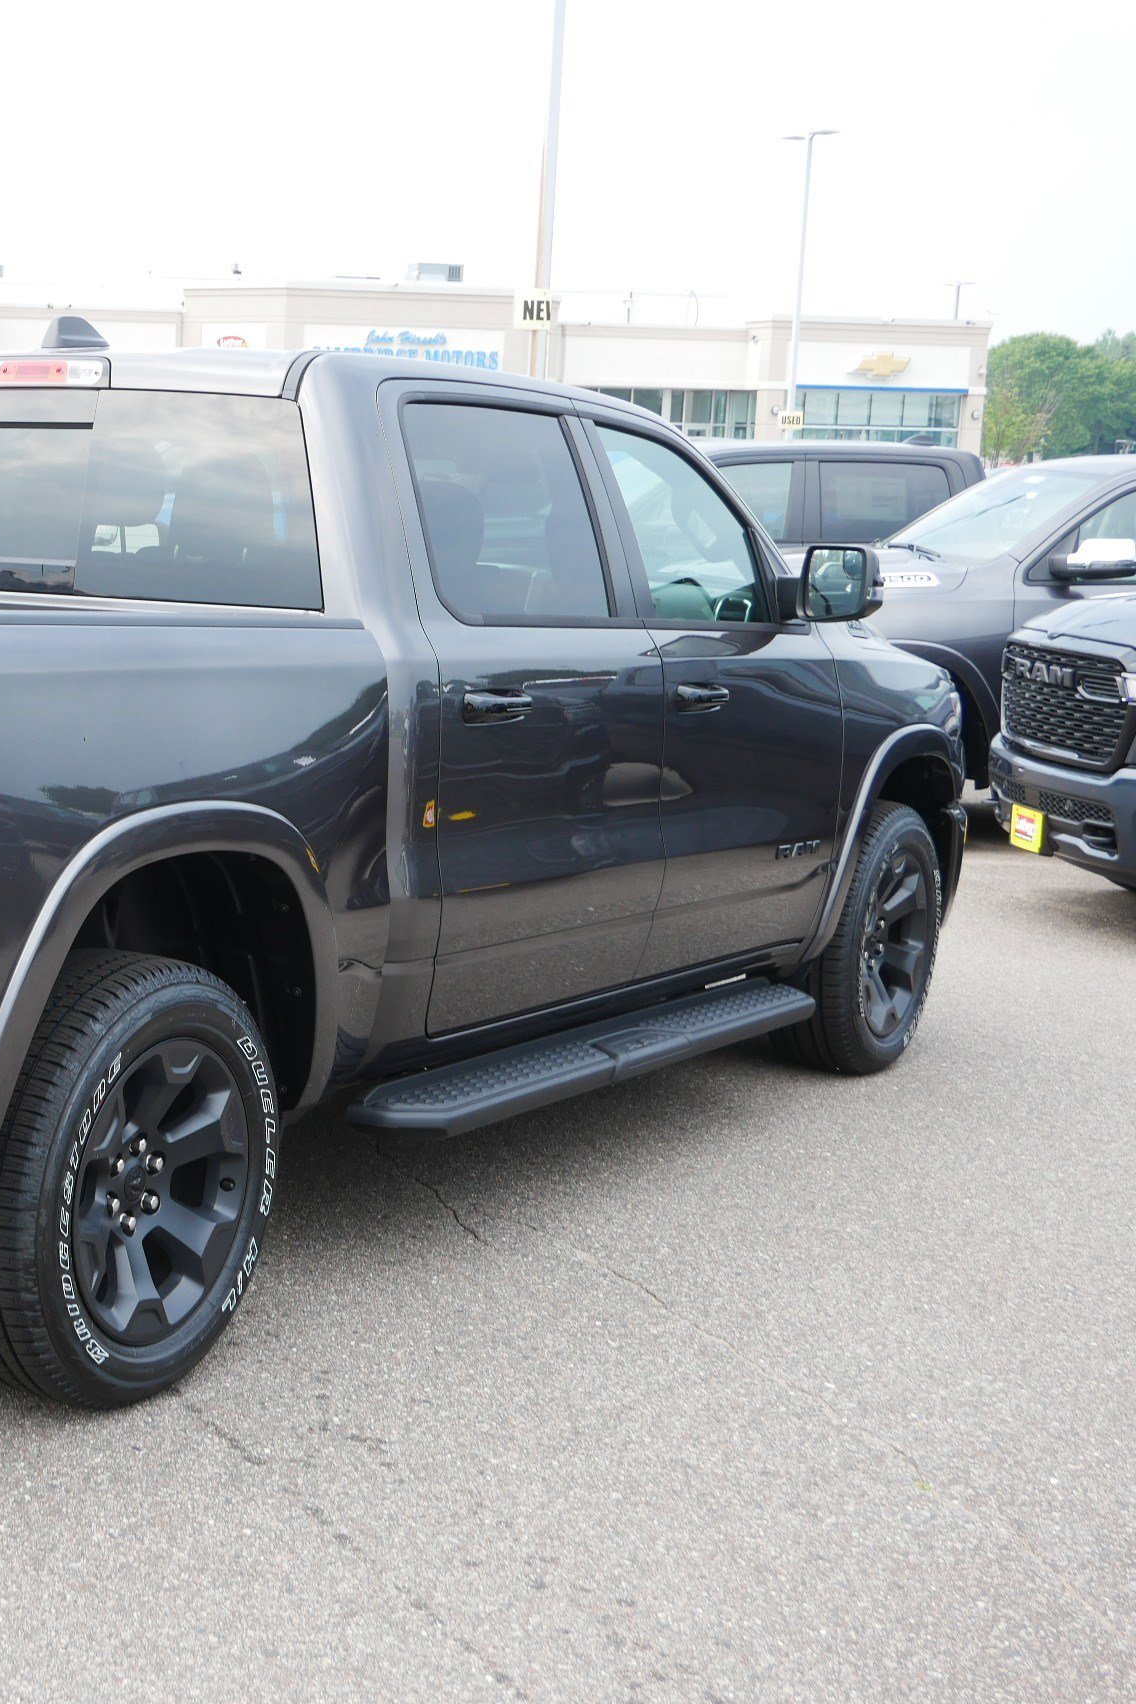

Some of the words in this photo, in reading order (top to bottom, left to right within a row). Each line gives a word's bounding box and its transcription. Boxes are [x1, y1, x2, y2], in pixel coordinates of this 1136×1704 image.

[424, 349, 499, 370] MOTORS
[781, 415, 801, 425] USED
[1014, 658, 1075, 689] RAM
[775, 839, 821, 859] RAM
[237, 1035, 277, 1217] DUELER
[58, 1051, 122, 1365] BRIDGESTONE
